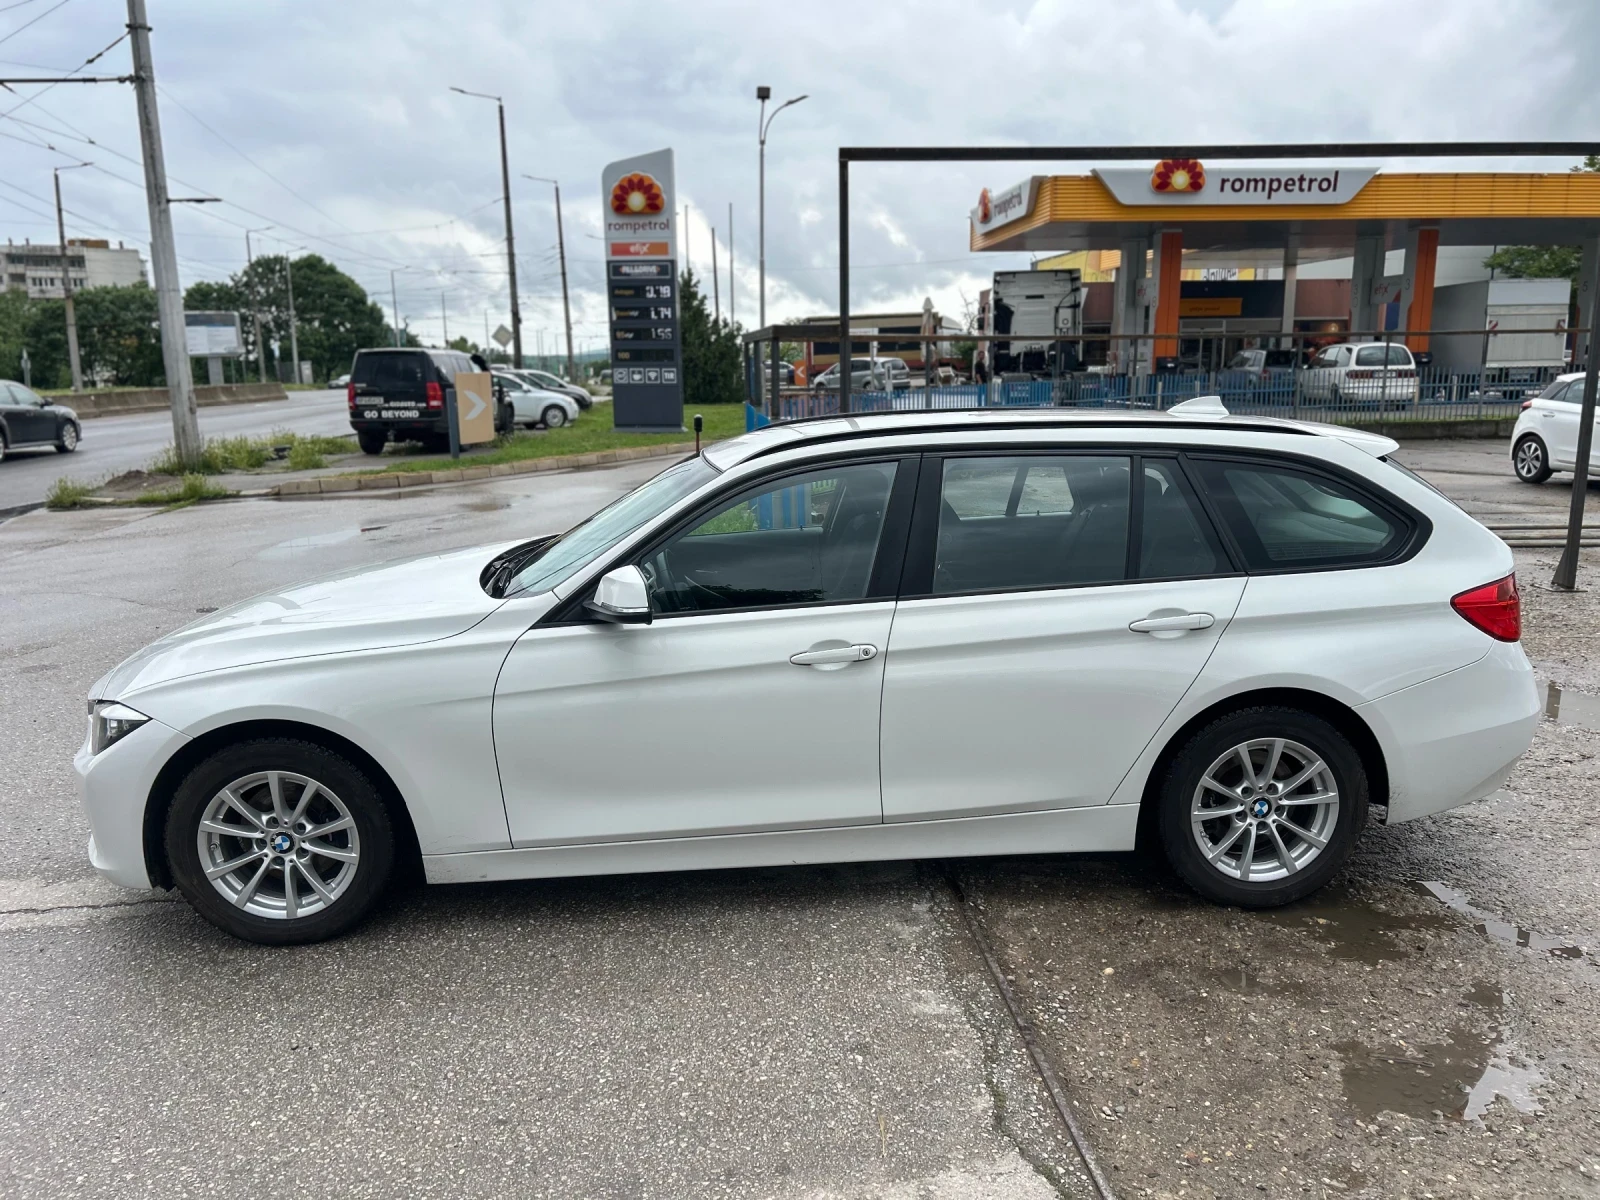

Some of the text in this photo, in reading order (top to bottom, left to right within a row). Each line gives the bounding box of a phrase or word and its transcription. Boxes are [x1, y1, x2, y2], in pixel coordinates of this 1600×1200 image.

[1219, 170, 1340, 200] rompetrol
[608, 219, 670, 234] rompetrol
[364, 410, 420, 419] GO BEYOND
